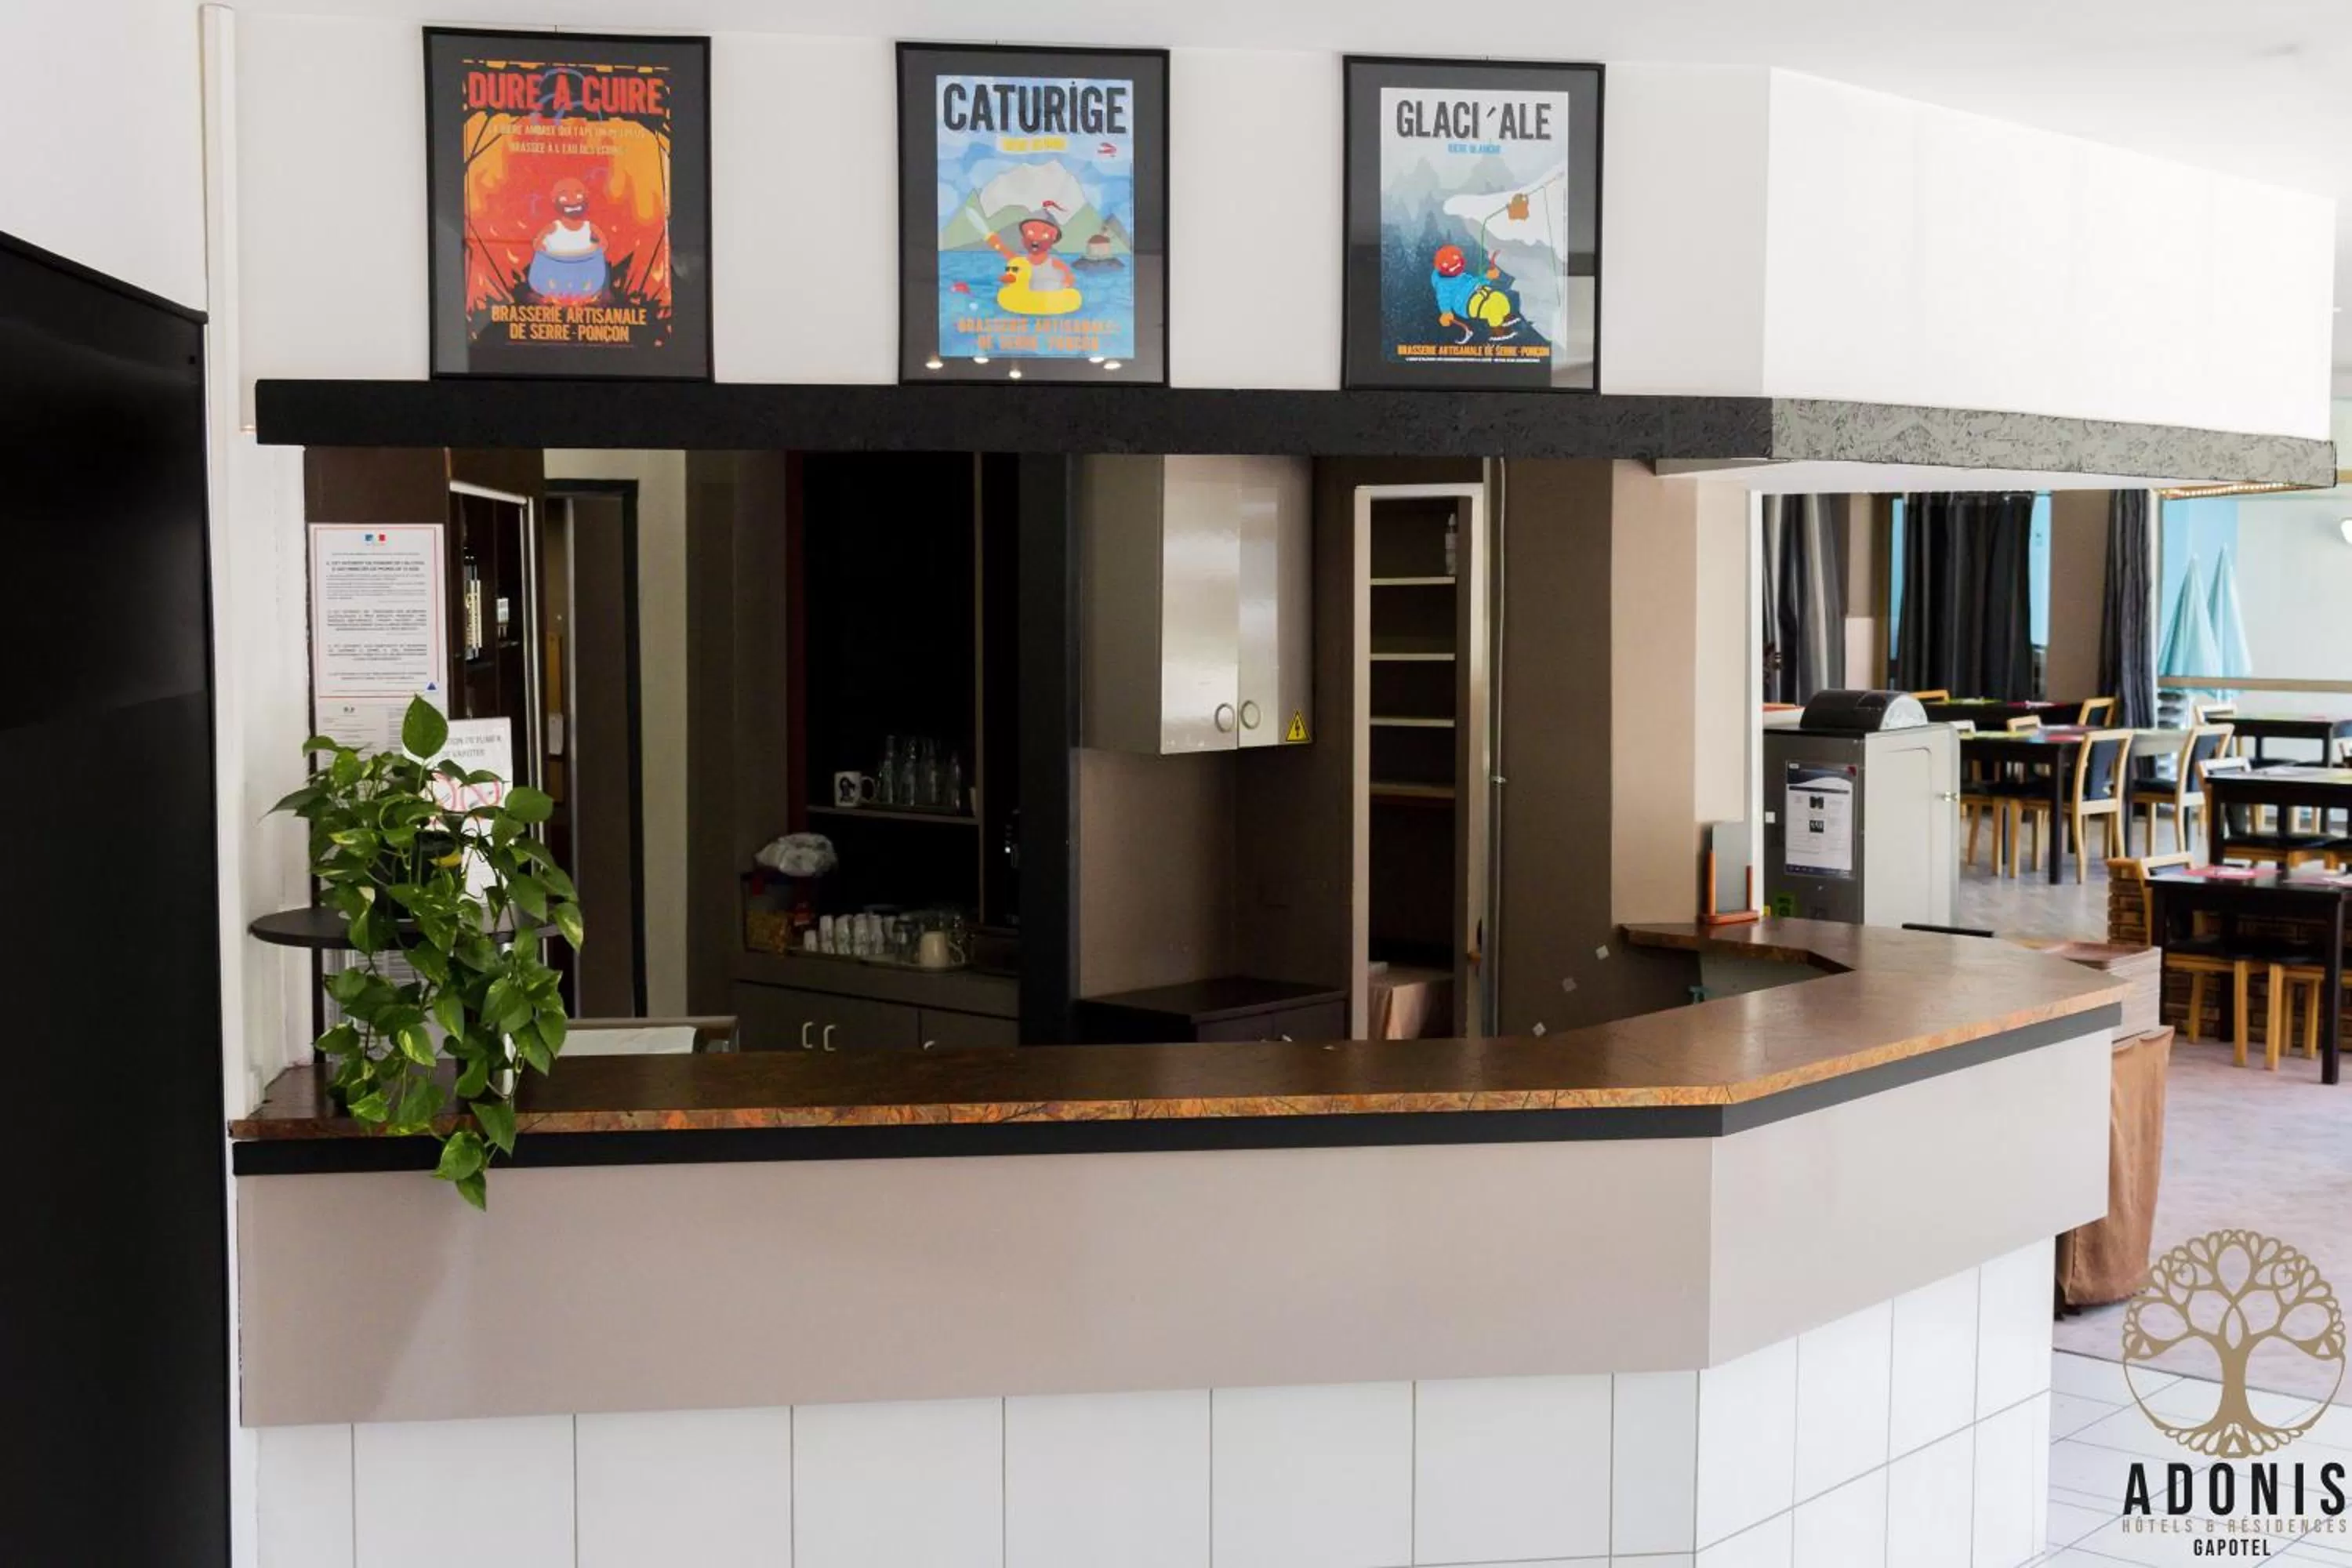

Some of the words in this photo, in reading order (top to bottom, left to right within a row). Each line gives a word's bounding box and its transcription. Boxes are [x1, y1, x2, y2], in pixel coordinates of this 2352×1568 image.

[468, 71, 543, 111] DURE
[582, 75, 665, 114] CUIRE
[492, 305, 563, 323] BRASSERIE
[567, 307, 647, 325] ARTISANALE
[510, 323, 527, 339] DE
